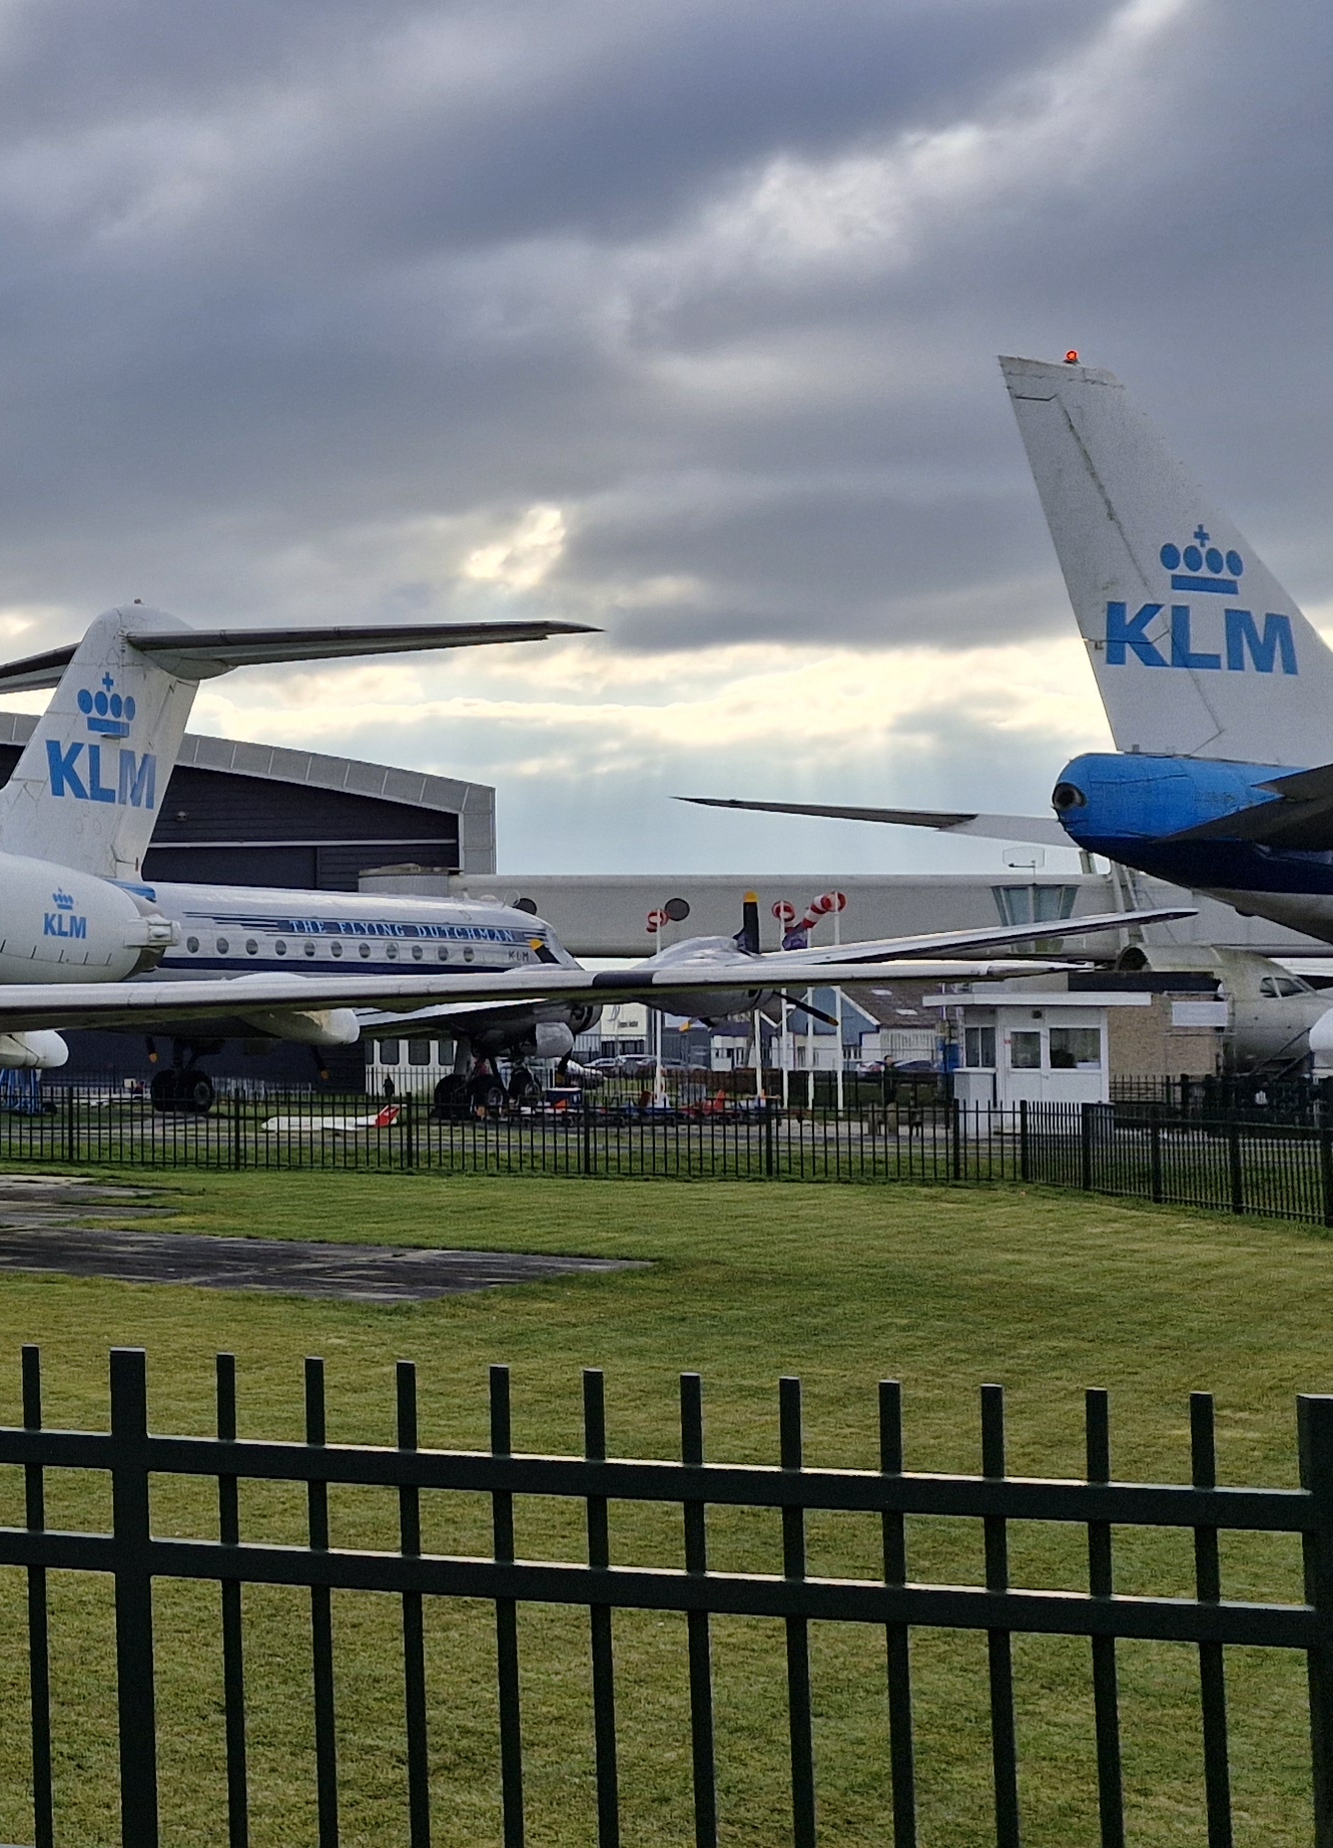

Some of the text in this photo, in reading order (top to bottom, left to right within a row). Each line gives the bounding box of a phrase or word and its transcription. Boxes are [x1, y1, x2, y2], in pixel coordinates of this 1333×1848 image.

[1106, 601, 1298, 675] KLM
[45, 739, 157, 810] KLM
[43, 912, 86, 939] KLM
[289, 920, 515, 942] THE FLYING DUTCHMAN
